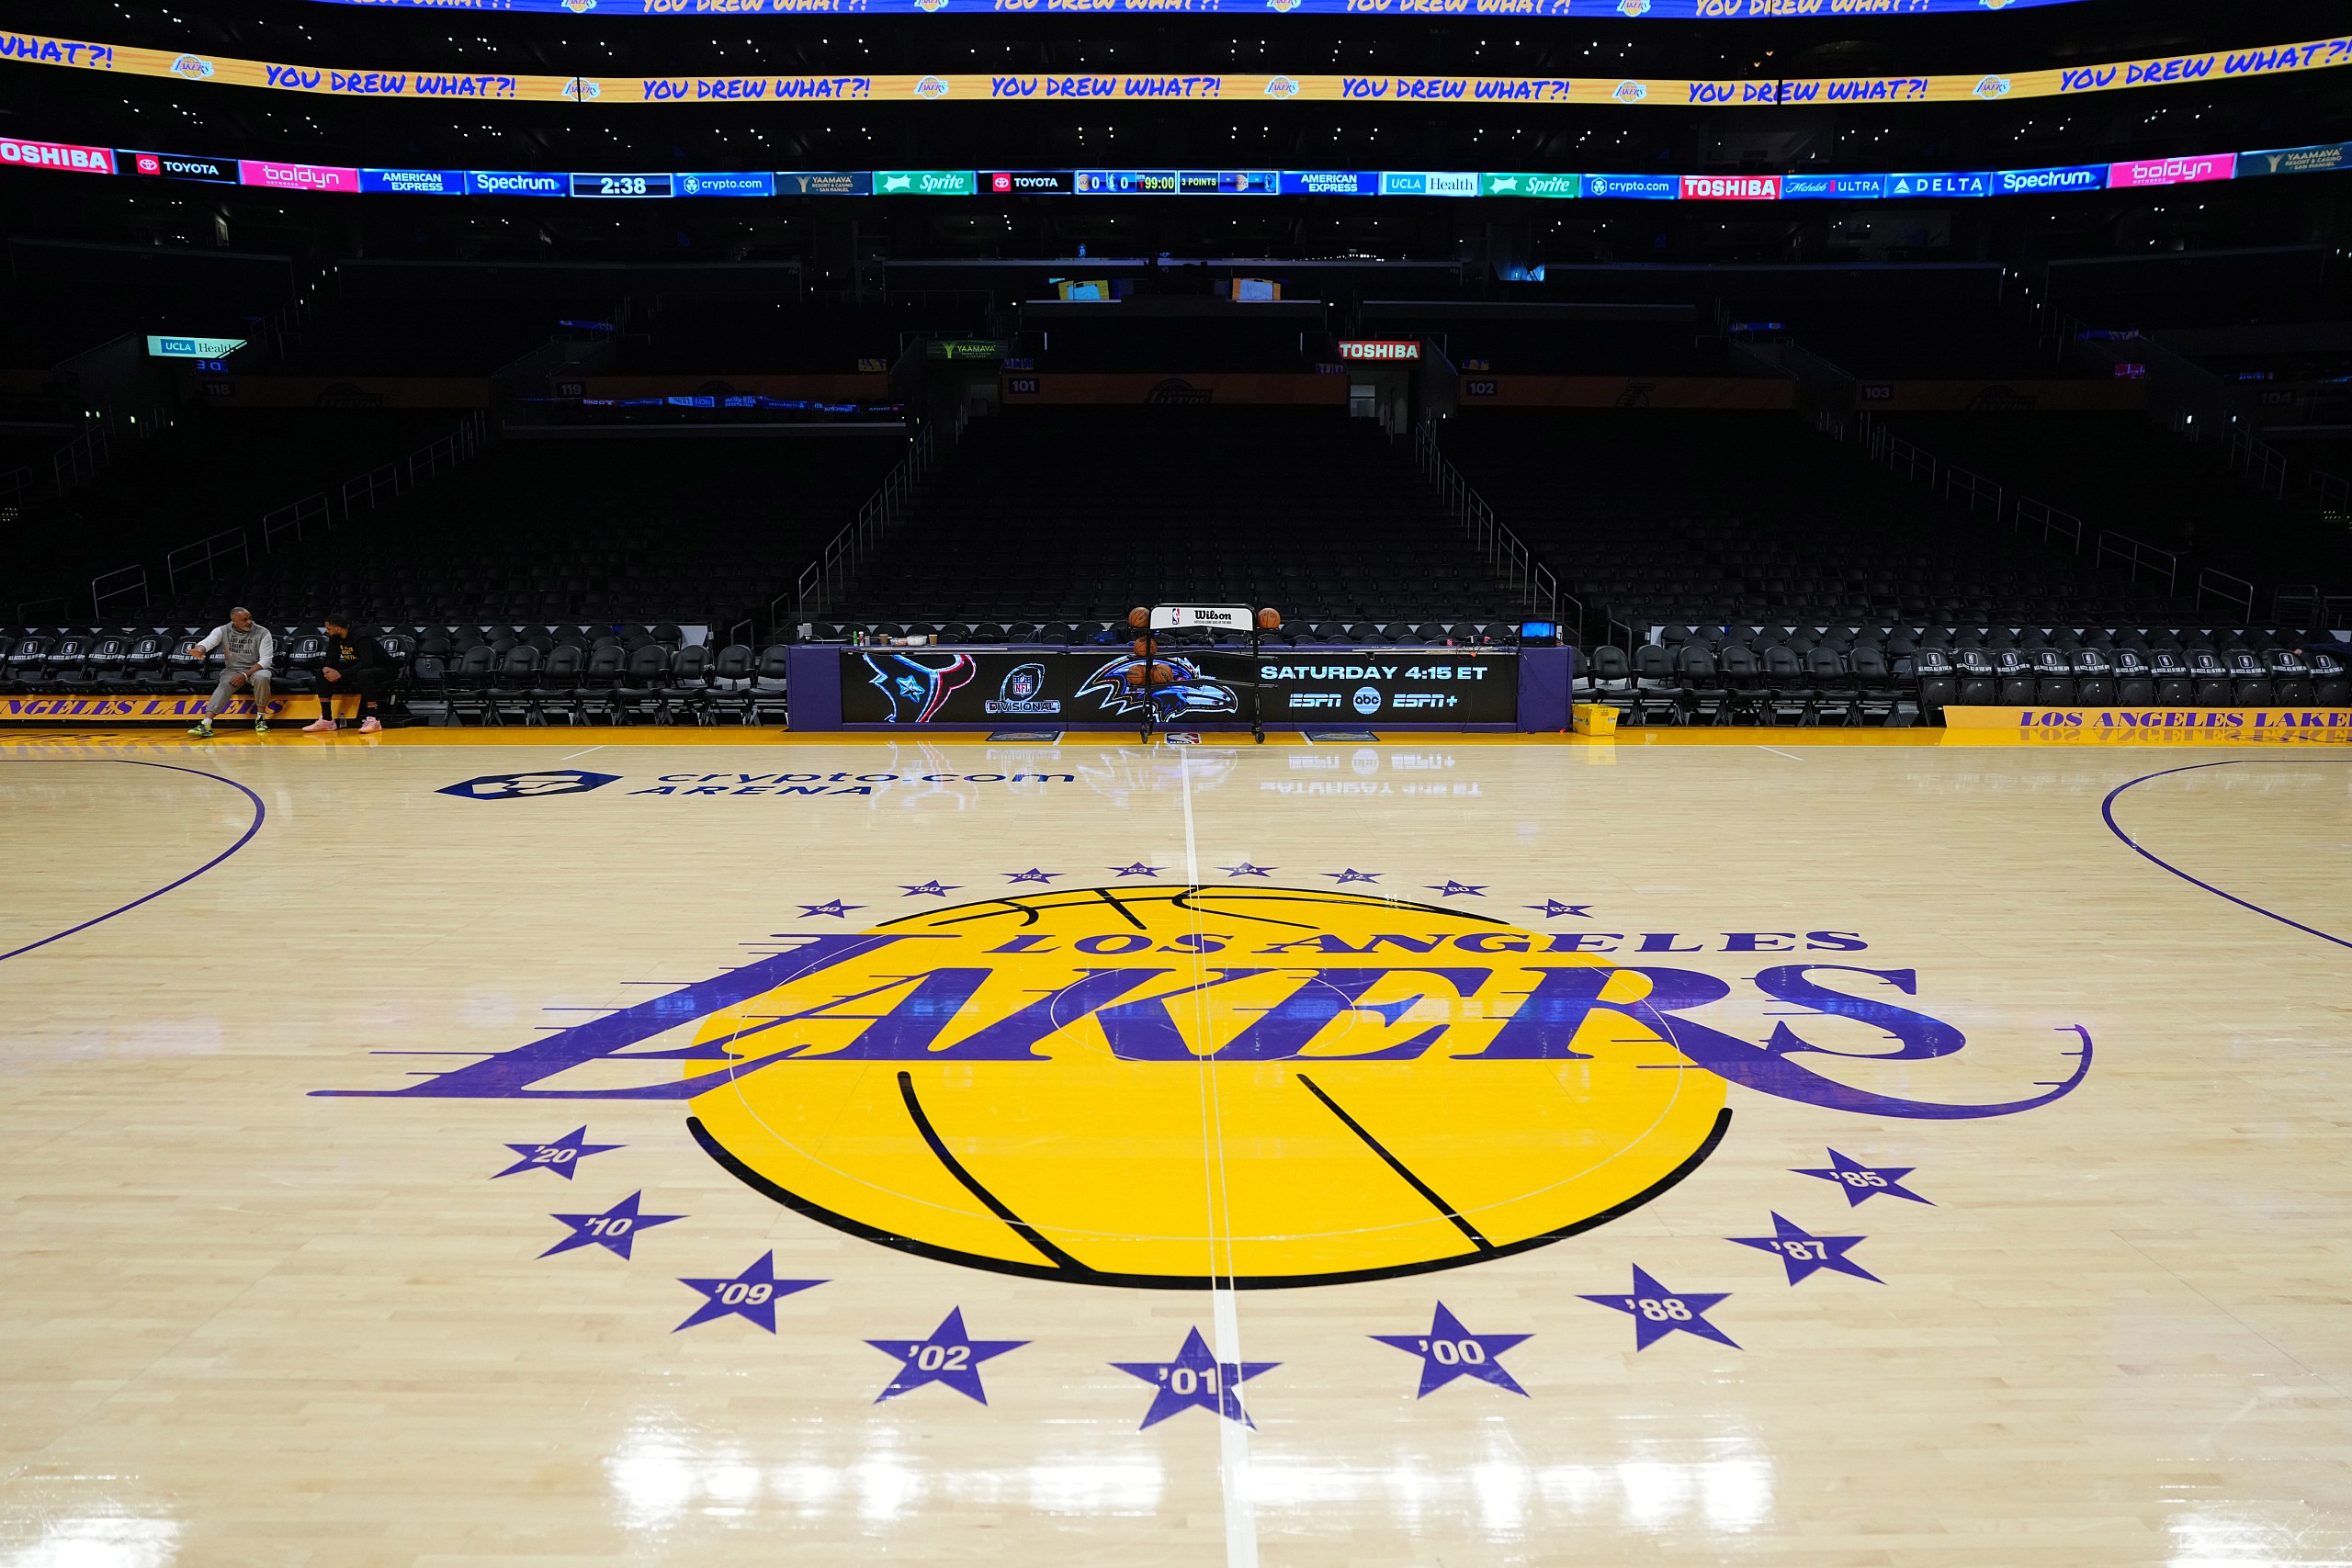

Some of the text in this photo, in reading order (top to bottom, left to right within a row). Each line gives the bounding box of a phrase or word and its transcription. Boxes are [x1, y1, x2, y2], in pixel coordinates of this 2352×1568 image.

[2060, 40, 2352, 92] YOU DREW WHAT?!
[266, 65, 515, 97] YOU DREW WHAT?!
[991, 77, 1221, 97] YOU DREW WHAT?!
[643, 78, 870, 100] YOU DREW WHAT?!
[1342, 78, 1570, 100] YOU DREW WHAT?!
[1689, 78, 1928, 103] YOU DREW WHAT?!
[163, 161, 220, 175] TOYOTA
[2132, 160, 2213, 181] boldyn
[262, 164, 340, 188] boldyn
[382, 172, 442, 183] AMERICAN
[476, 174, 556, 193] Spectrum
[919, 173, 965, 193] Sprite
[1013, 177, 1058, 187] TOYOTA
[1091, 176, 1101, 189] 0
[1120, 176, 1129, 189] 0
[1145, 176, 1175, 189] 99:00
[1188, 177, 1217, 186] POINTS
[1300, 174, 1358, 184] AMERICAN
[2002, 171, 2090, 193] Spectrum
[390, 181, 444, 192] EXPRESS
[600, 176, 647, 196] 2:38
[701, 178, 763, 190] crypto.com
[1308, 183, 1359, 193] EXPRESS
[1391, 177, 1474, 191] UCLA Health
[1525, 175, 1571, 195] Sprite
[1609, 180, 1670, 193] crypto.com
[1684, 179, 1776, 197] TOSHIBA
[1838, 180, 1880, 192] ULTRA
[1916, 177, 1983, 192] DELTA
[165, 341, 193, 352] UCLA
[1340, 344, 1419, 358] TOSHIBA
[1011, 379, 1035, 392] 101
[1469, 382, 1495, 394] 102
[1864, 387, 1891, 399] 103
[1193, 609, 1232, 620] Wilson
[1260, 666, 1488, 680] SATURDAY 4:15 ET
[1014, 683, 1030, 696] NFL
[989, 702, 1057, 713] DIVISIONAL
[1288, 693, 1459, 708] ESPN abc ESPN+
[2018, 712, 2084, 728] LOS
[2092, 712, 2245, 728] ANGELES
[657, 772, 1075, 784] crypto.com
[625, 785, 872, 795] ARENA
[982, 933, 1869, 954] LOS ANGELES
[308, 933, 2093, 1121] LAKERS
[535, 1145, 578, 1165] '20
[1830, 1169, 1884, 1191] '85
[583, 1216, 633, 1237] '10
[1770, 1237, 1826, 1263] '87
[716, 1281, 774, 1306] '09
[1624, 1296, 1693, 1323] '88
[907, 1344, 972, 1373] '02
[1418, 1338, 1486, 1367] '00
[1158, 1366, 1219, 1396] '01
